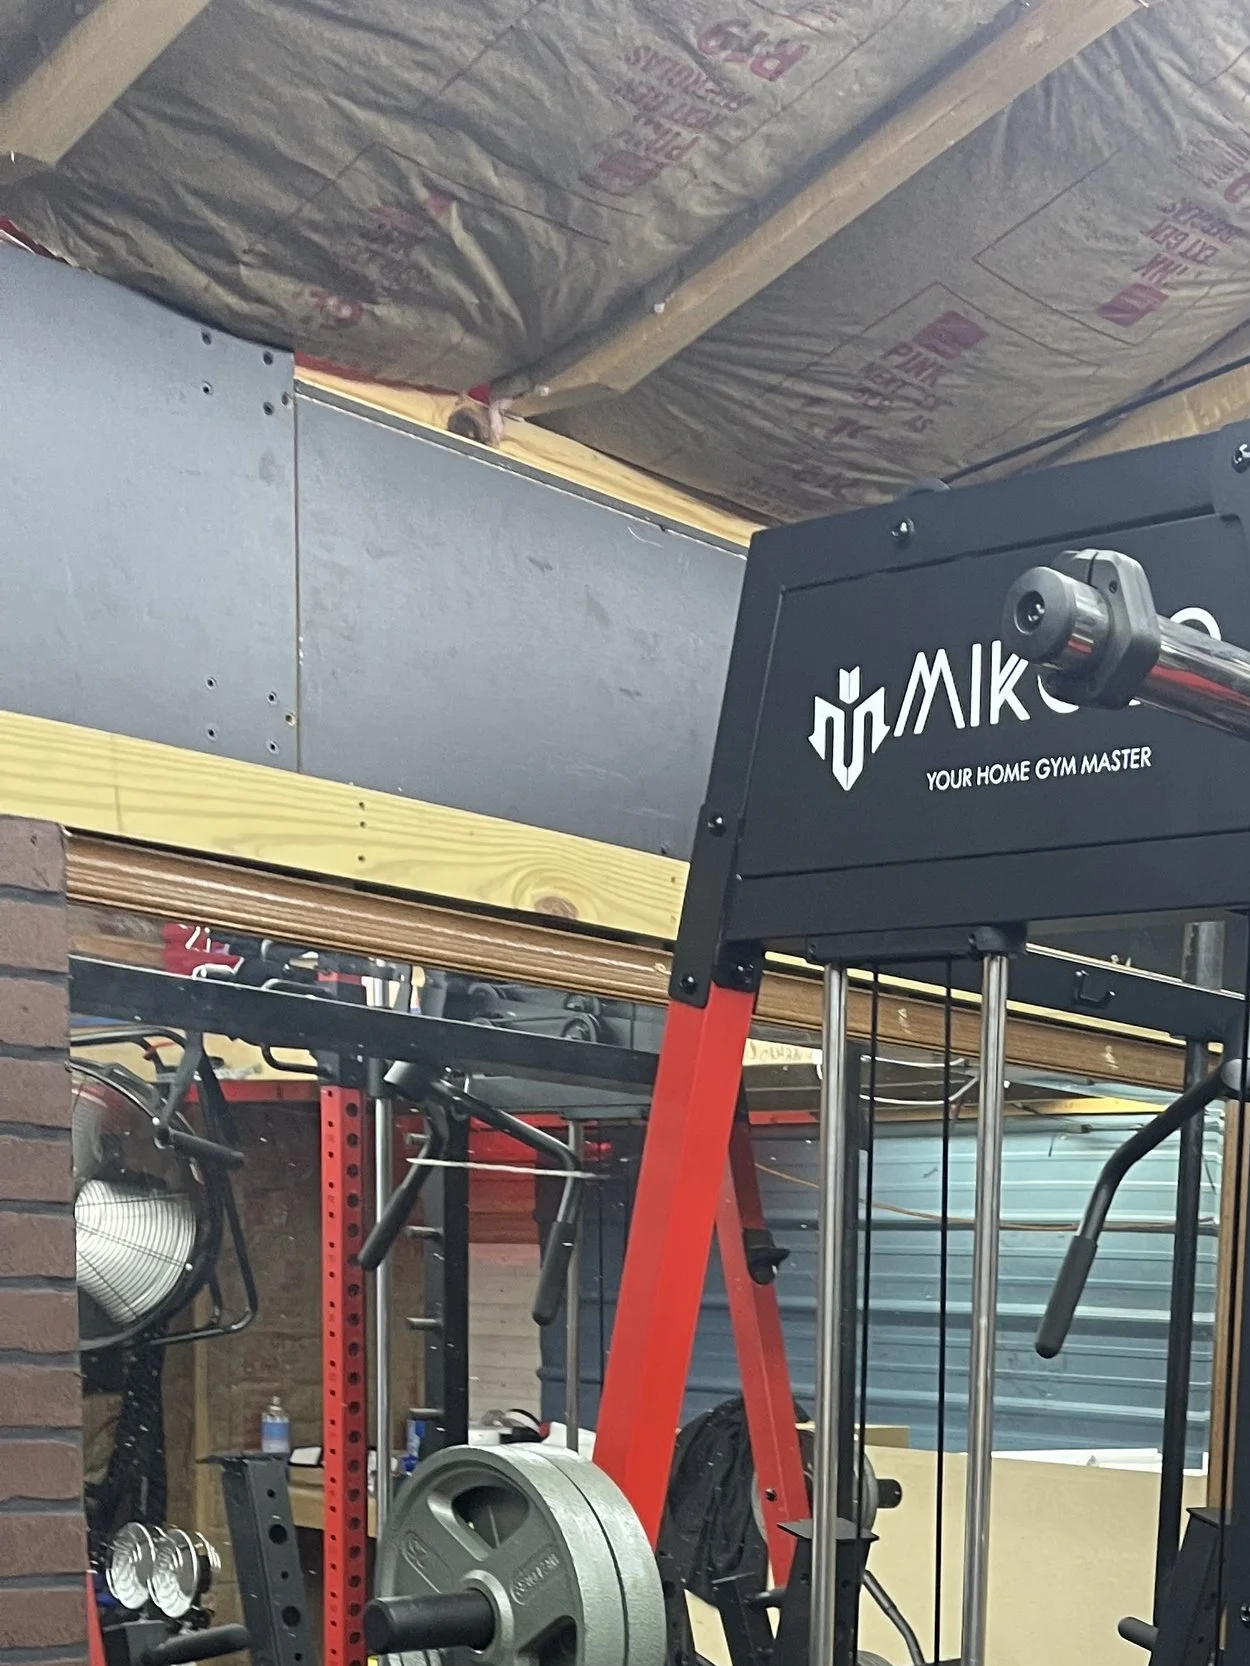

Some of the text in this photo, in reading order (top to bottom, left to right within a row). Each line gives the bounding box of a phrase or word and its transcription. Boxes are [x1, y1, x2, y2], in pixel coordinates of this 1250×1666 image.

[926, 746, 1153, 792] YOUR HOME GYM MASTER
